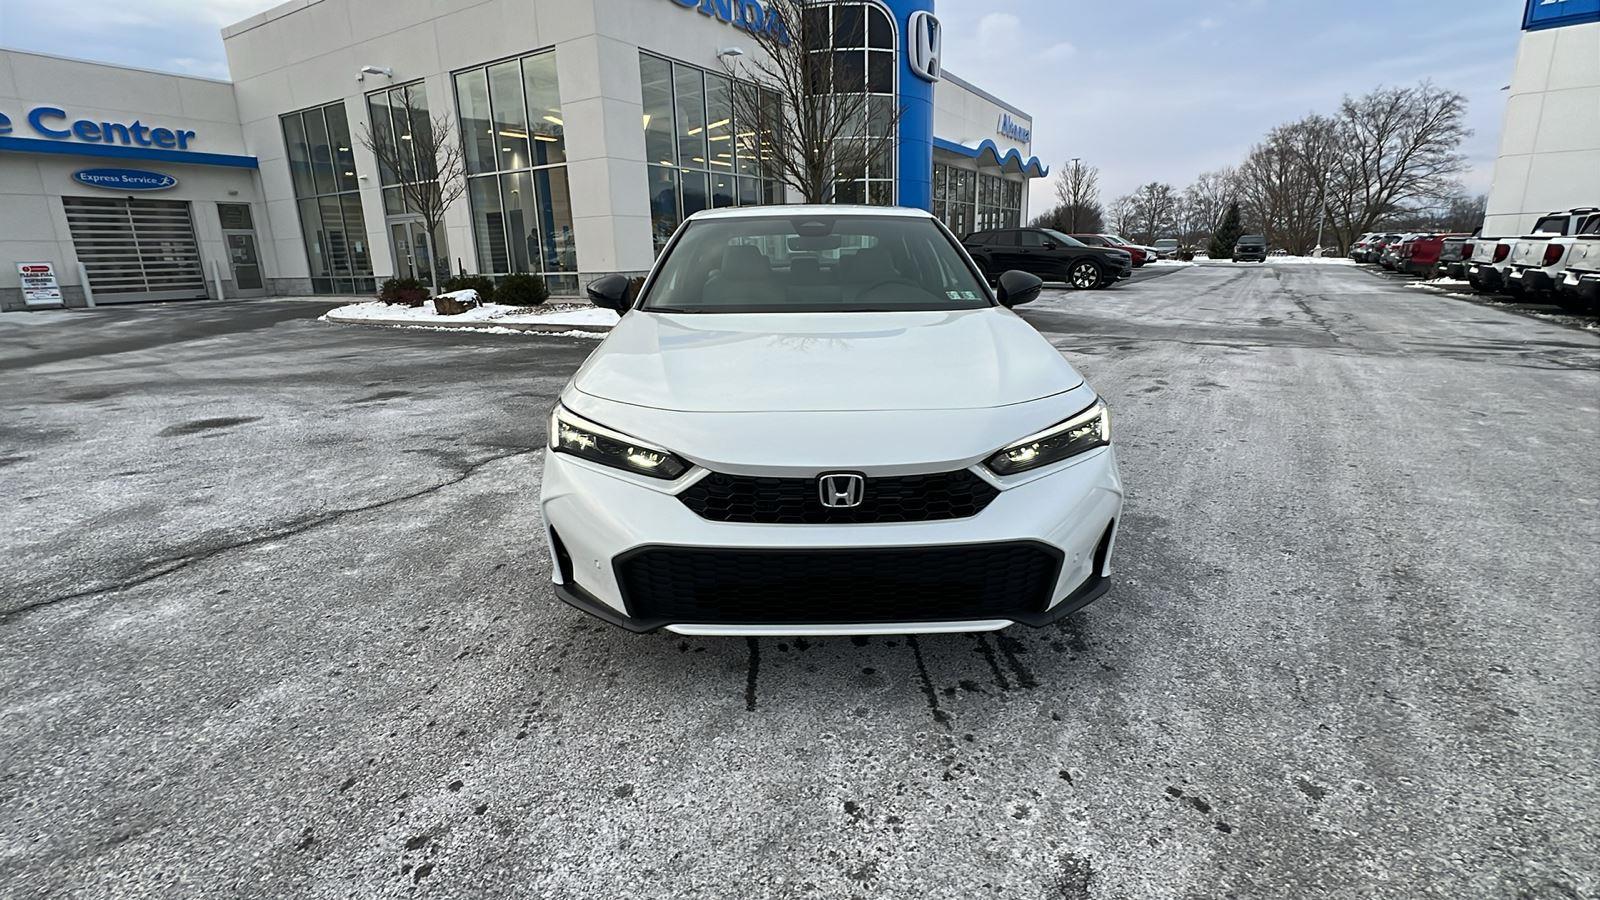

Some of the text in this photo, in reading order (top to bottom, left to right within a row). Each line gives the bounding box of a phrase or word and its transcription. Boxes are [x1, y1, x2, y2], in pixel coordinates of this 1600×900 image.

[28, 107, 196, 149] Center
[80, 172, 158, 184] Express Service
